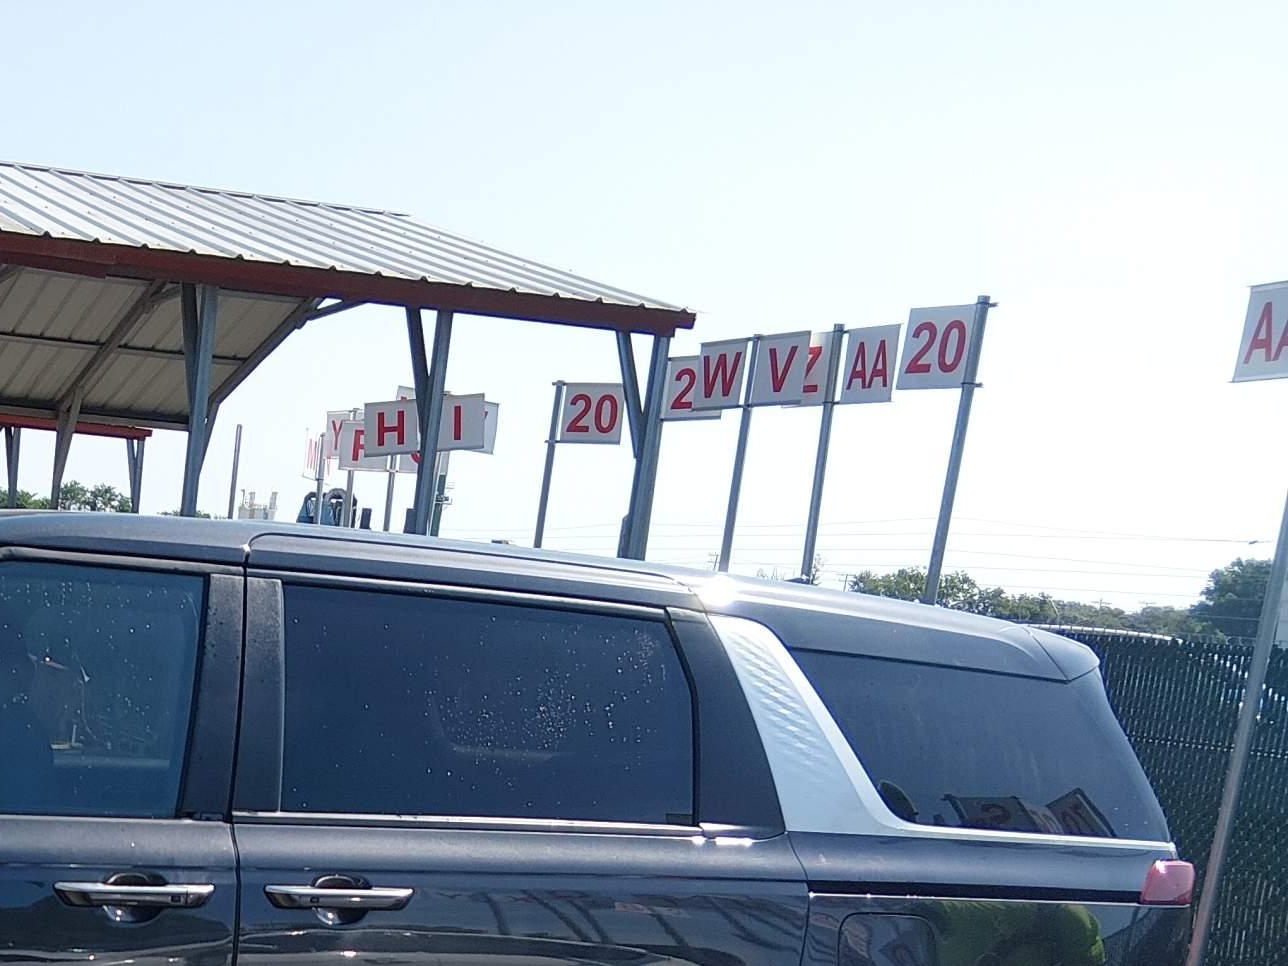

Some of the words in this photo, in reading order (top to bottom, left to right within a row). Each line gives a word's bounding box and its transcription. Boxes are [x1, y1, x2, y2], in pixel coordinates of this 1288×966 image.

[769, 345, 798, 393] V
[846, 339, 888, 390] AA
[905, 319, 966, 375] 20
[704, 351, 742, 398] W
[377, 410, 405, 446] H
[453, 405, 462, 441] I
[566, 393, 618, 433] 20
